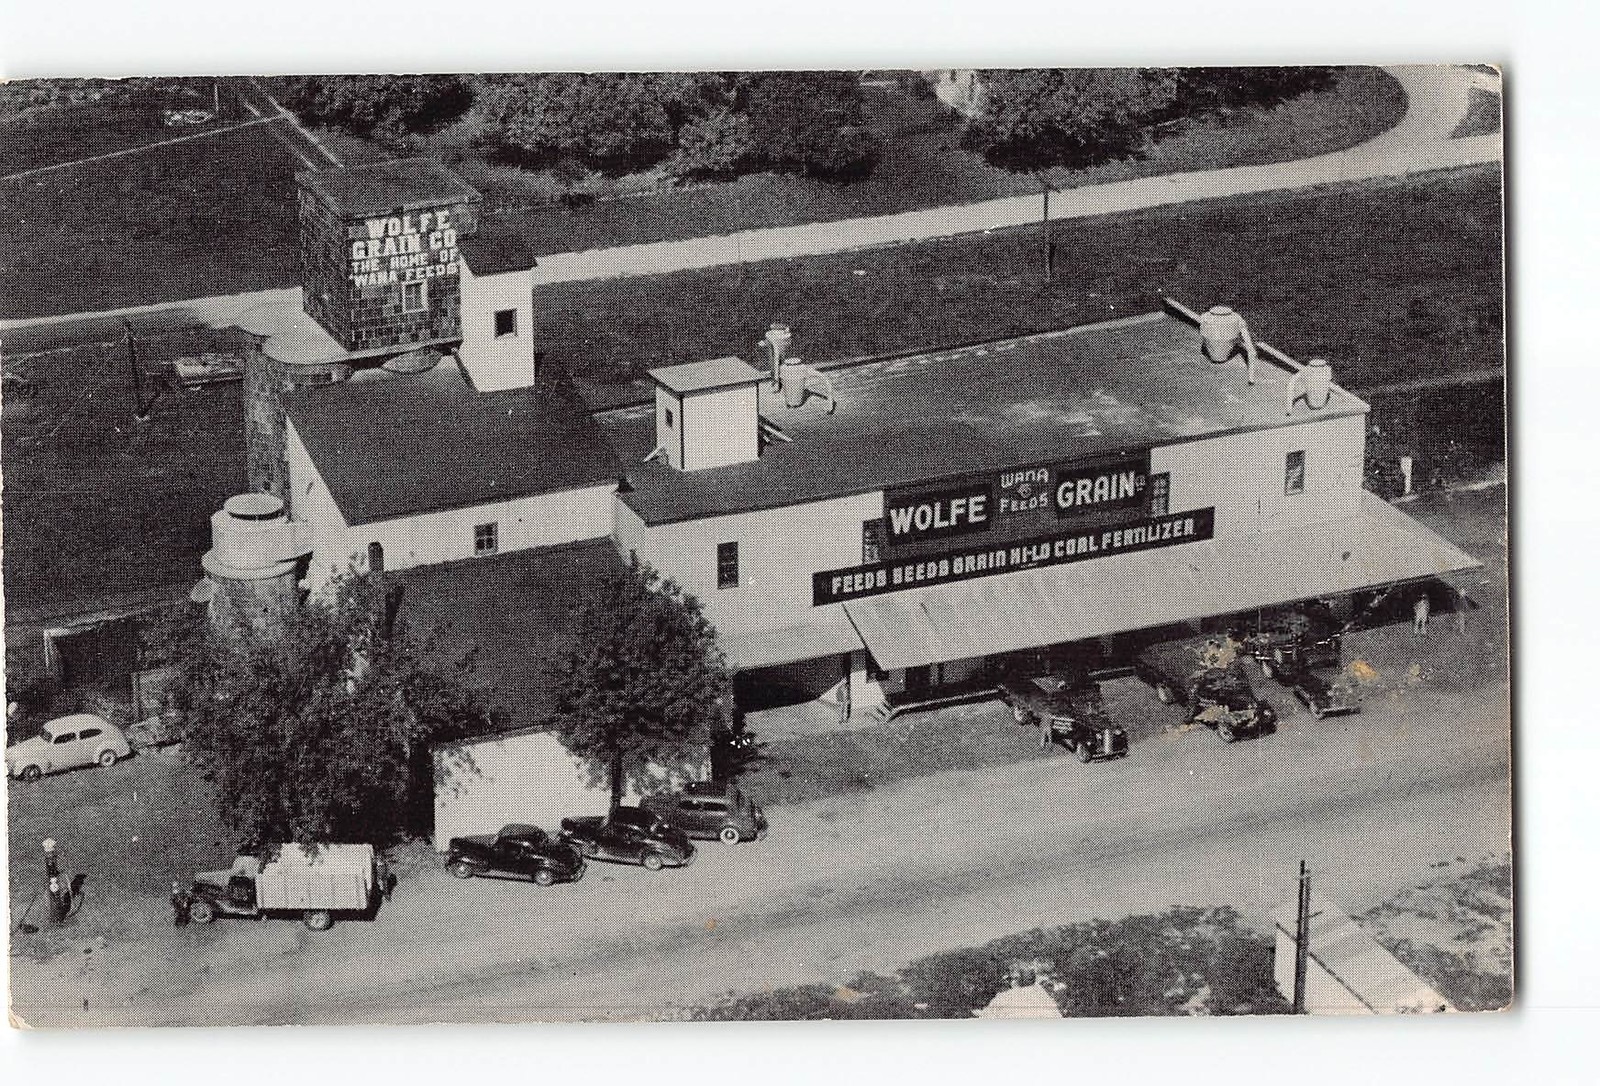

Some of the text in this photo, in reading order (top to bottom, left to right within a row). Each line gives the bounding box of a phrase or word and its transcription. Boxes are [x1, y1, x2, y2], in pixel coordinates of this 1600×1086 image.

[365, 209, 450, 239] WOLFE
[352, 228, 457, 261] GRAIN CO
[351, 247, 459, 274] THE HOME OF
[1000, 467, 1050, 489] WANA
[1056, 471, 1135, 509] GRAIN
[890, 495, 988, 536] WOLFE
[1000, 492, 1049, 513] FEEDS
[831, 569, 887, 595] FEEDS
[892, 559, 949, 585] SEEDS
[952, 549, 1006, 575] GRAIN
[1054, 535, 1099, 558] COAL
[1101, 517, 1195, 550] FERTILIZER
